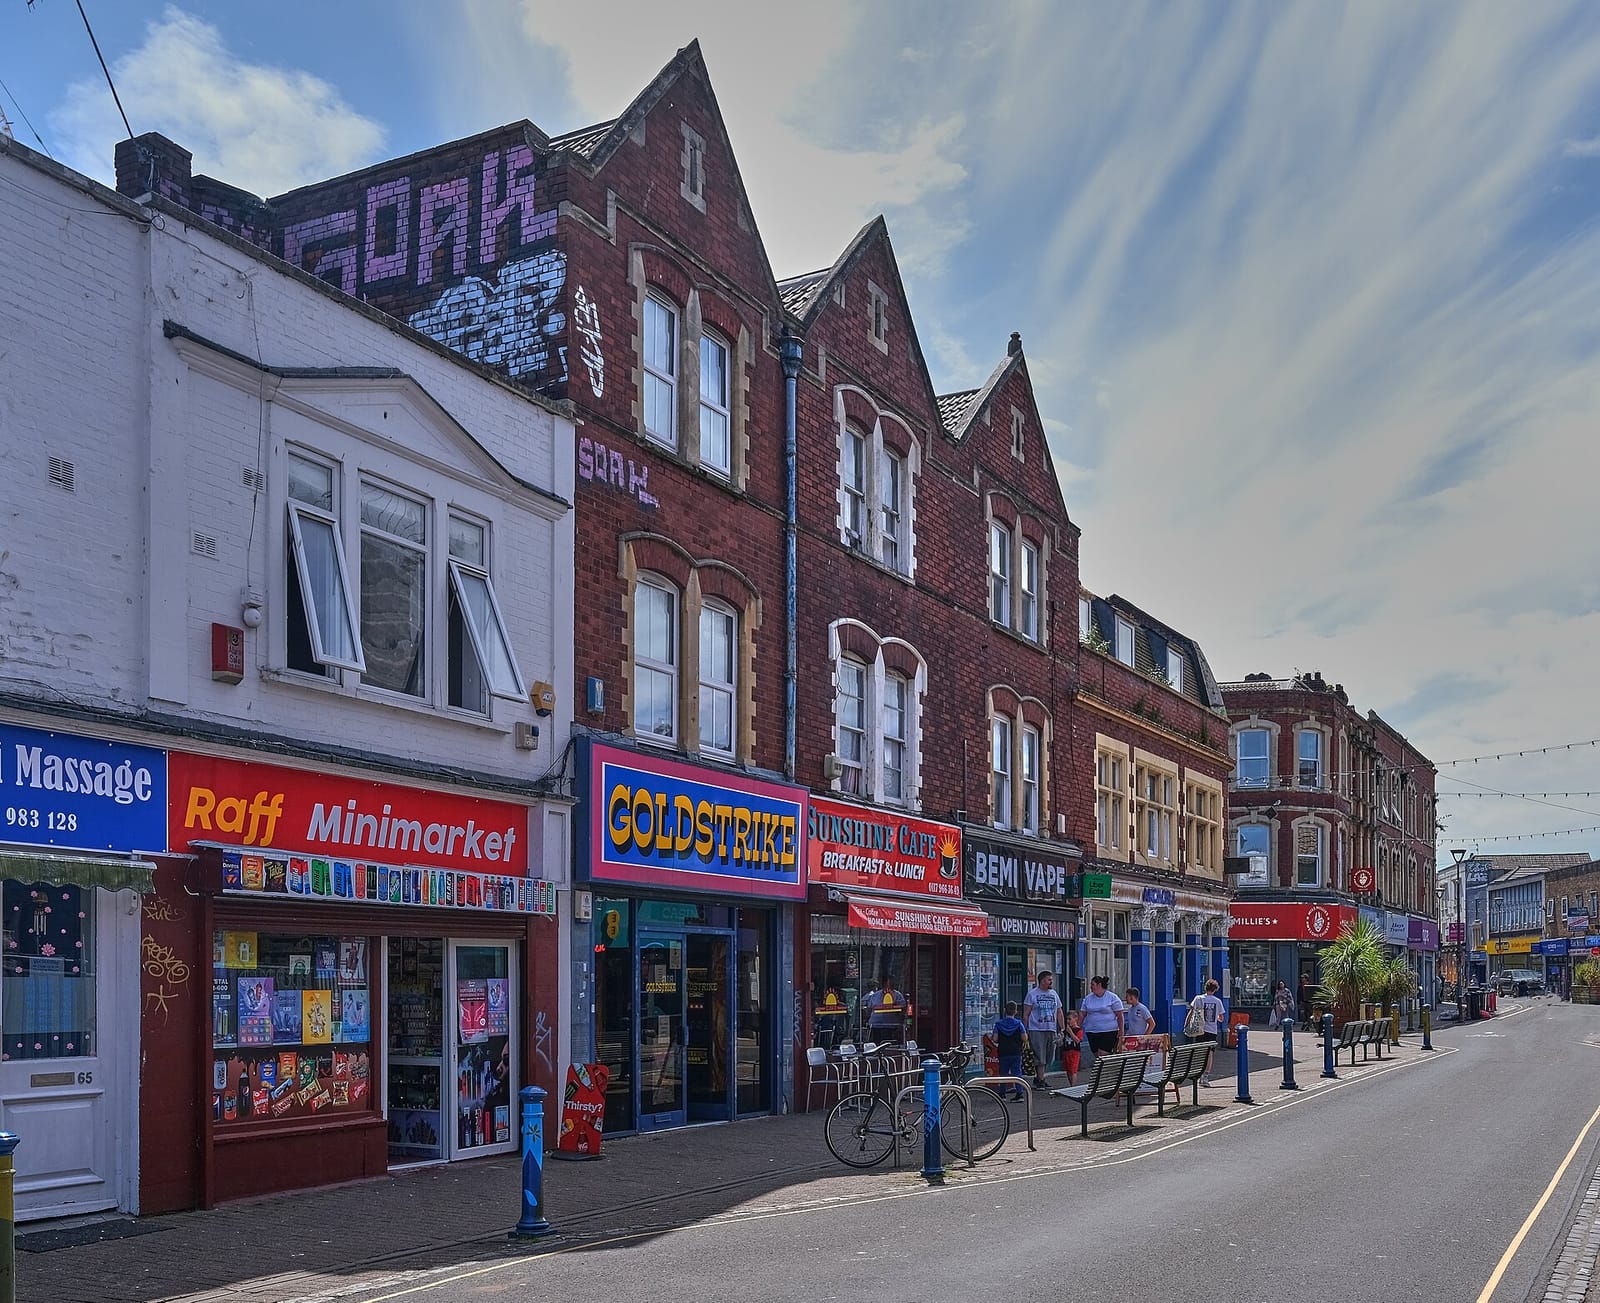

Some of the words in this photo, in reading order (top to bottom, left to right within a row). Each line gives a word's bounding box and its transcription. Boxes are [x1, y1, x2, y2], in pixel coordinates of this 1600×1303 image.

[15, 744, 151, 804] Massage
[6, 807, 39, 827] 983
[47, 811, 77, 831] 128
[184, 786, 285, 847] Raff
[306, 799, 515, 862] Minimarket
[608, 783, 796, 870] GOLDSTRIKE
[808, 805, 894, 852] SUNSHINE
[899, 824, 937, 860] CAFE
[822, 851, 884, 874] BREAKFAST
[884, 862, 894, 876] &
[894, 862, 926, 881] LUNCH
[976, 852, 1018, 888] BEMI
[1024, 860, 1066, 894] VAPE
[867, 916, 884, 925] HOME
[885, 919, 901, 927] MADE
[902, 920, 920, 929] FRESH
[920, 922, 933, 931] FOOD
[933, 923, 953, 932] SERVED
[895, 910, 931, 923] SUNSHINE
[932, 914, 950, 926] CAFE
[1001, 918, 1023, 933] OPEN
[1023, 920, 1029, 934] 7
[1030, 920, 1049, 935] DAYS
[1233, 917, 1271, 926] MILLIE'S
[646, 982, 677, 992] GOLDSTRIKE
[78, 1071, 93, 1084] 65
[565, 1100, 602, 1113] Thirsty?
